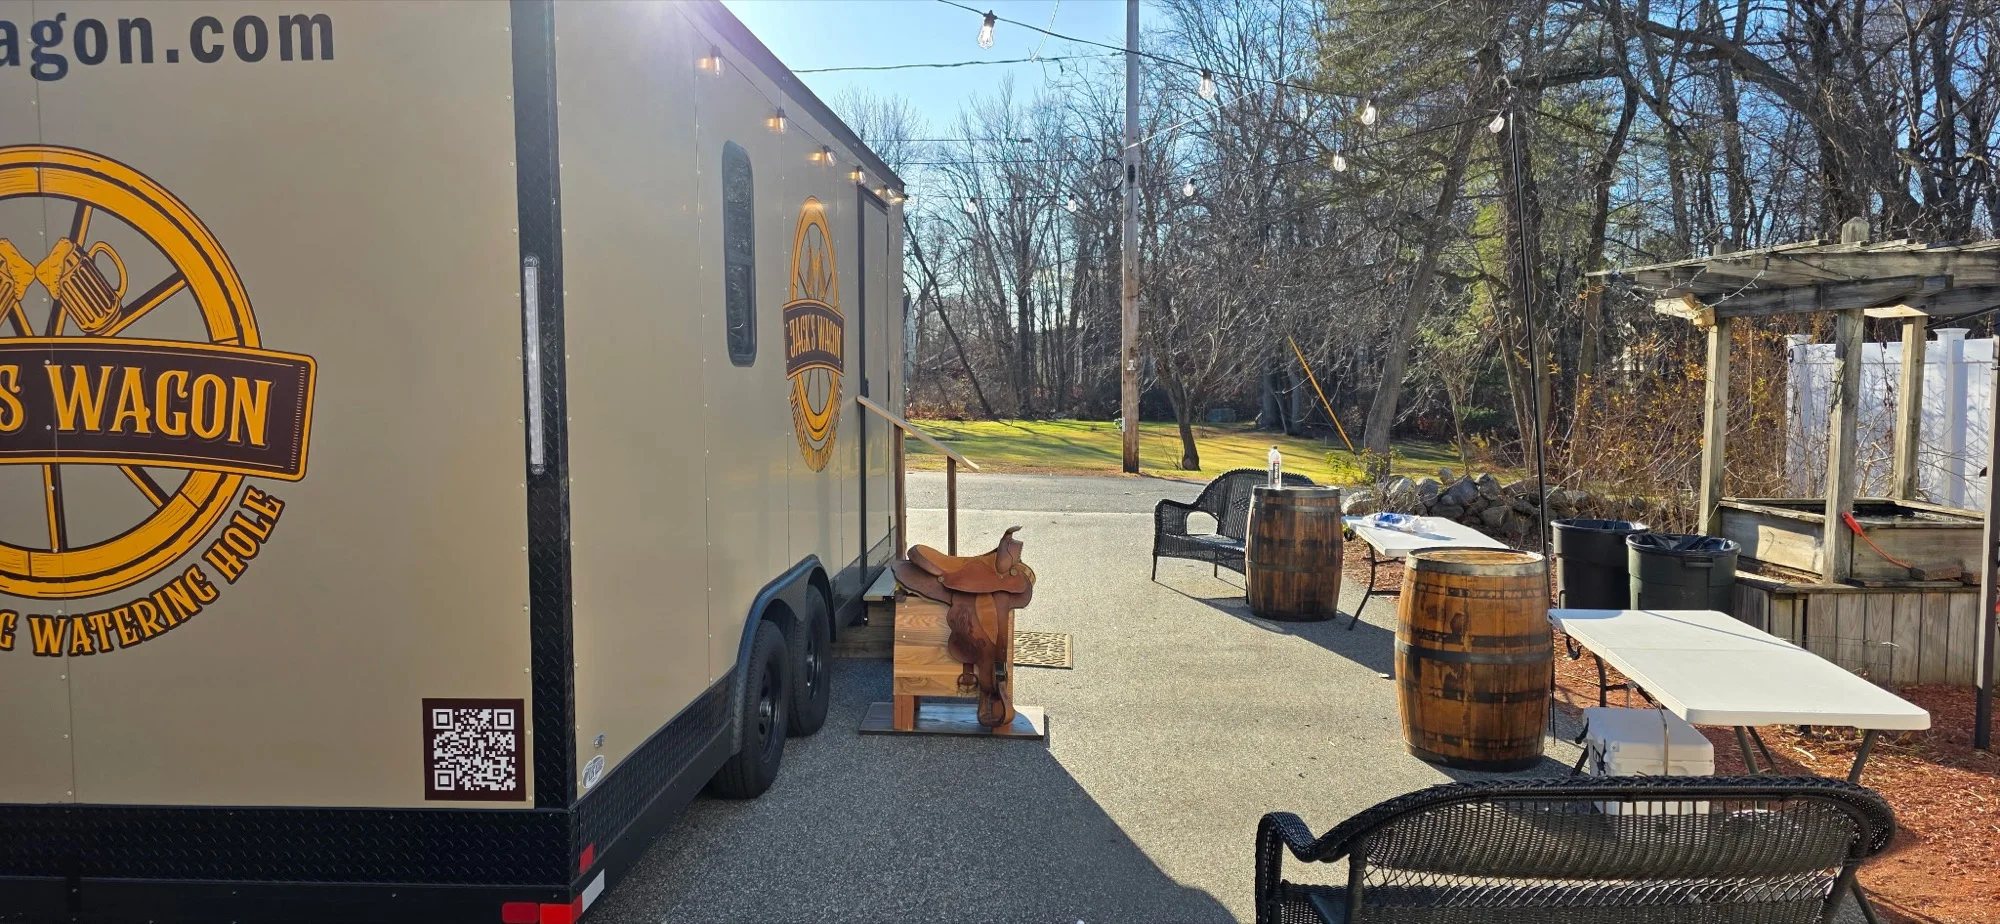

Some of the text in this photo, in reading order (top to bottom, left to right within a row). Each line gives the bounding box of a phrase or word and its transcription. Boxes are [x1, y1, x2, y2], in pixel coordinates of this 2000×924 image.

[817, 315, 841, 360] WAGON
[45, 364, 272, 446] WAGON
[29, 565, 219, 655] WATERING
[203, 486, 284, 583] HOLE
